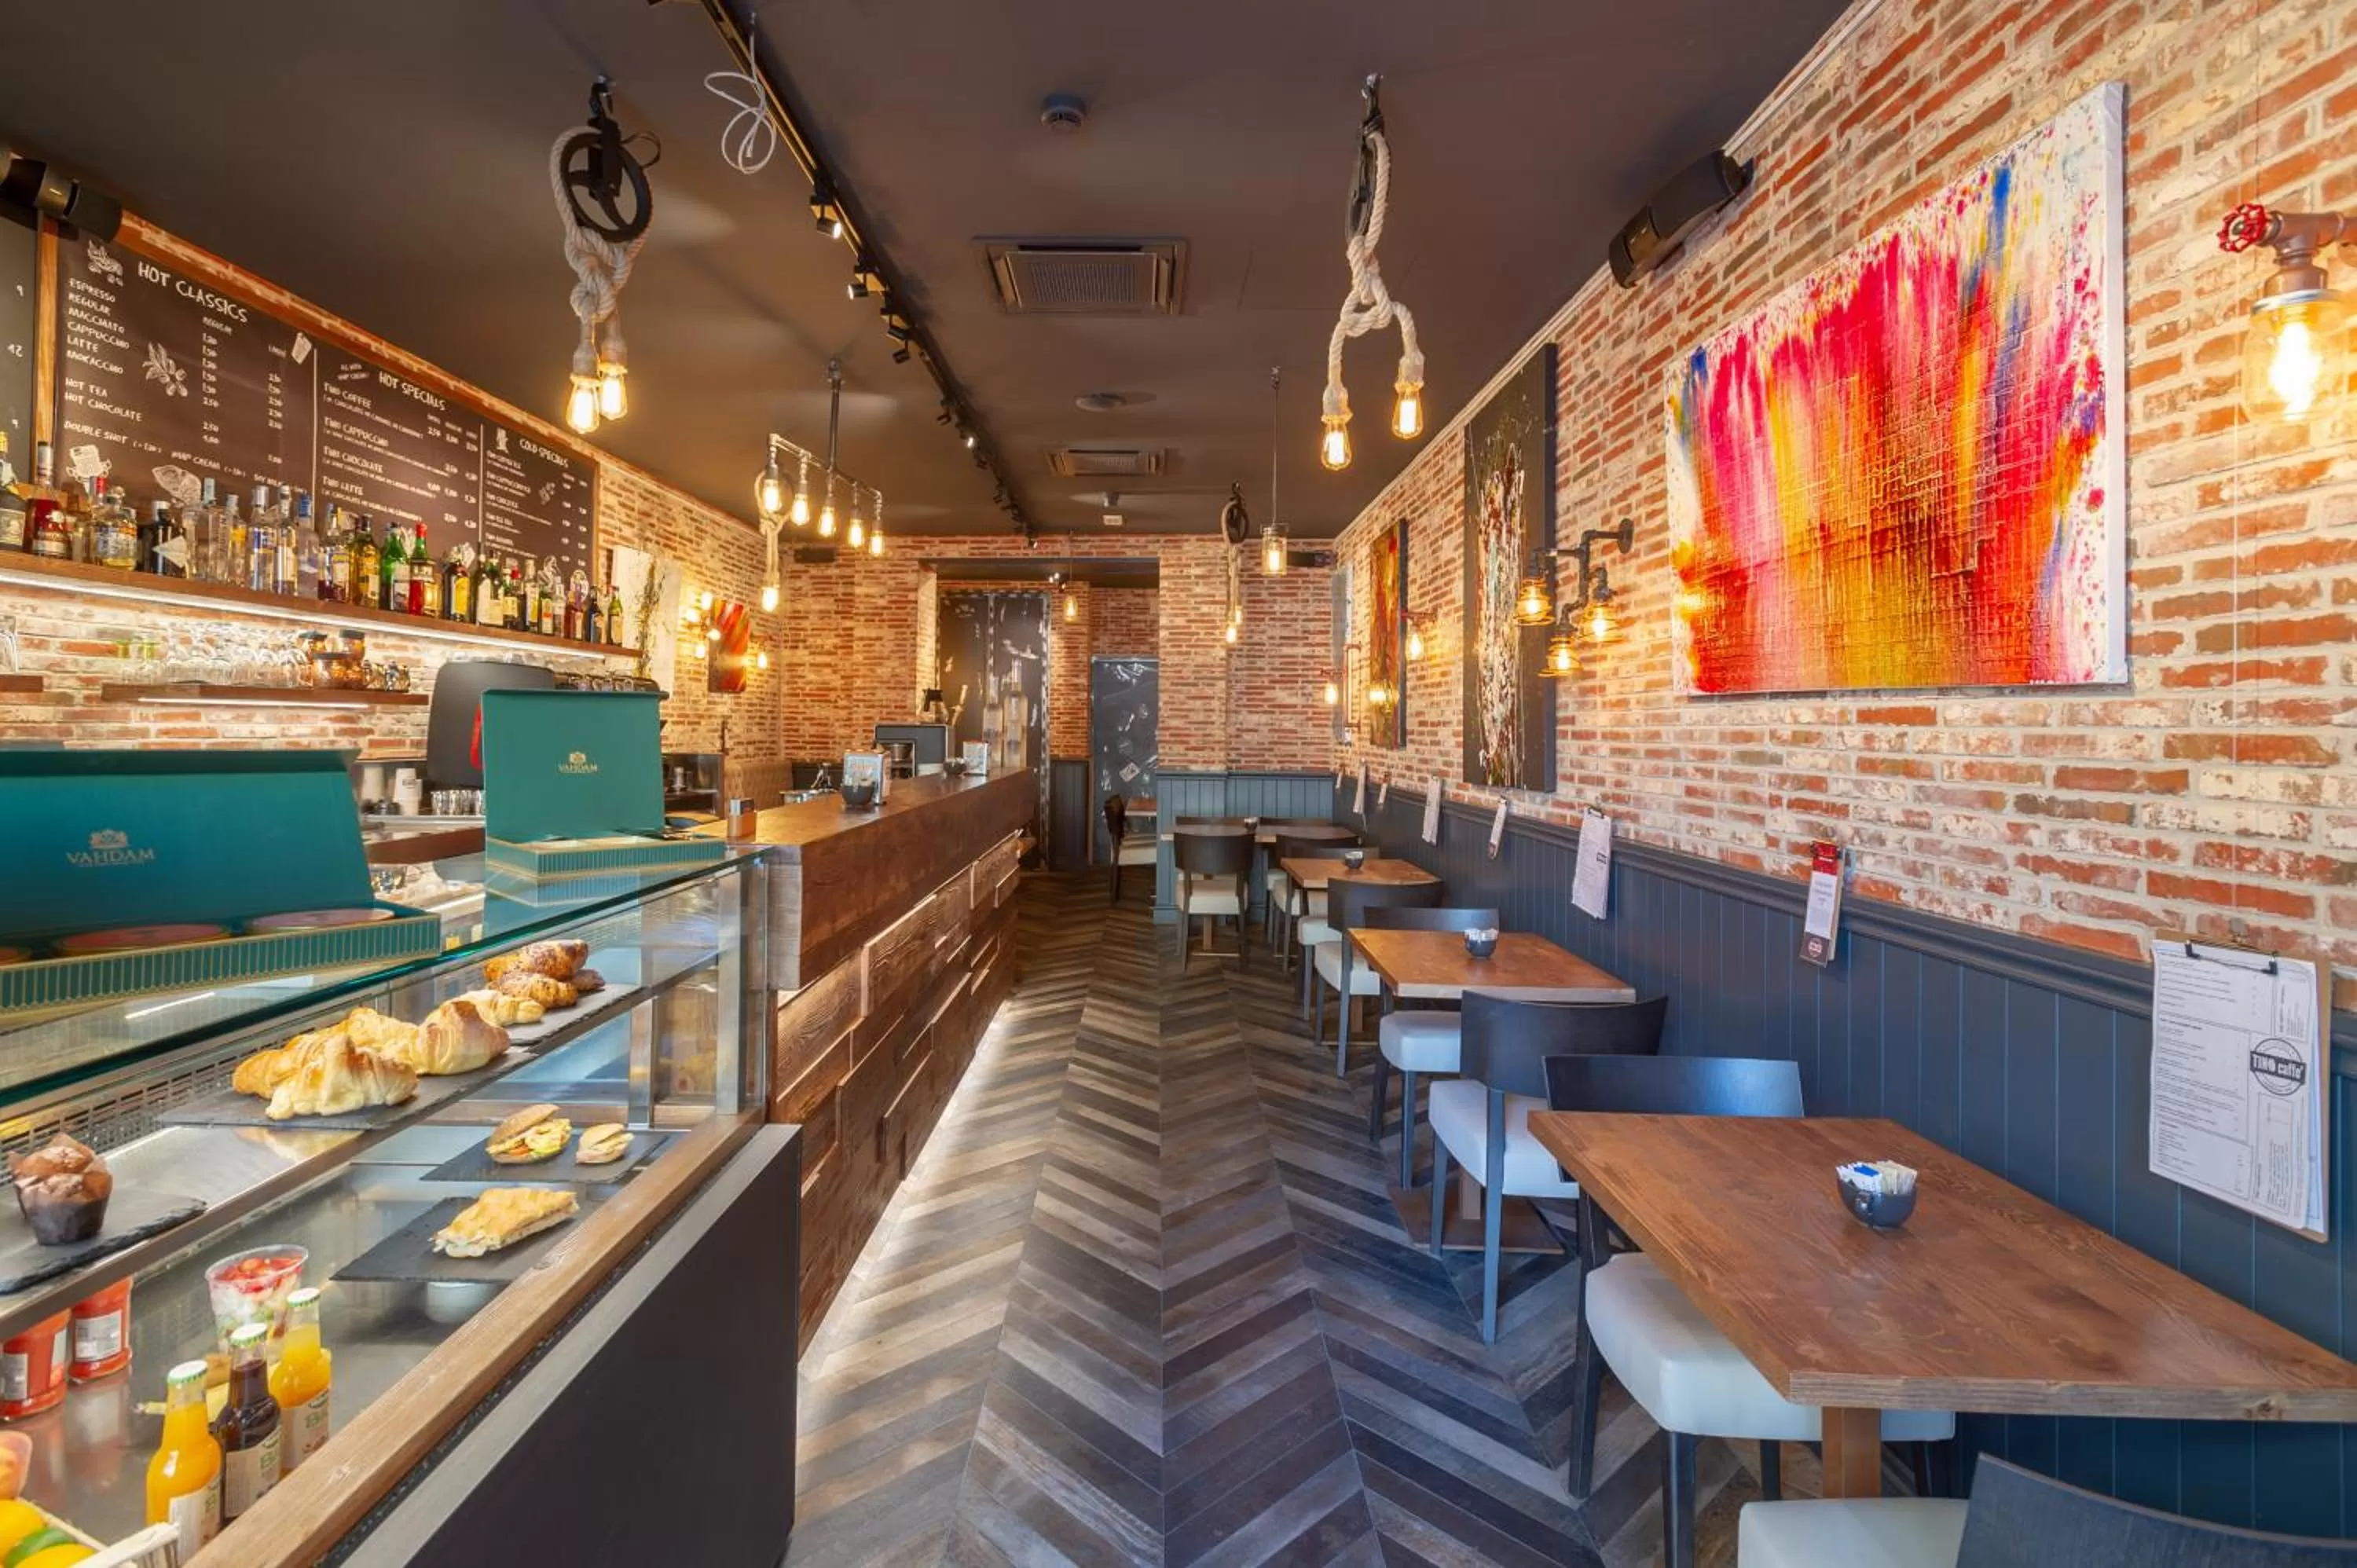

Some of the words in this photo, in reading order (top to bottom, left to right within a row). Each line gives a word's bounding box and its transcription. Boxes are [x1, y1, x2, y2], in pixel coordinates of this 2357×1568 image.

[69, 277, 116, 303] ESPRESSO
[137, 260, 170, 287] HOT
[175, 280, 248, 324] CLASSICS
[68, 292, 112, 316] REGULAR
[67, 335, 99, 353] LATTE
[64, 377, 85, 390] HOT
[89, 384, 108, 397] TEA
[379, 370, 399, 390] HOT
[401, 383, 446, 411] SPECIALS
[64, 392, 85, 405] HOT
[88, 399, 144, 422] CHOCOLATE
[64, 420, 101, 438] DOUBLE
[65, 848, 156, 865] VAHDAM
